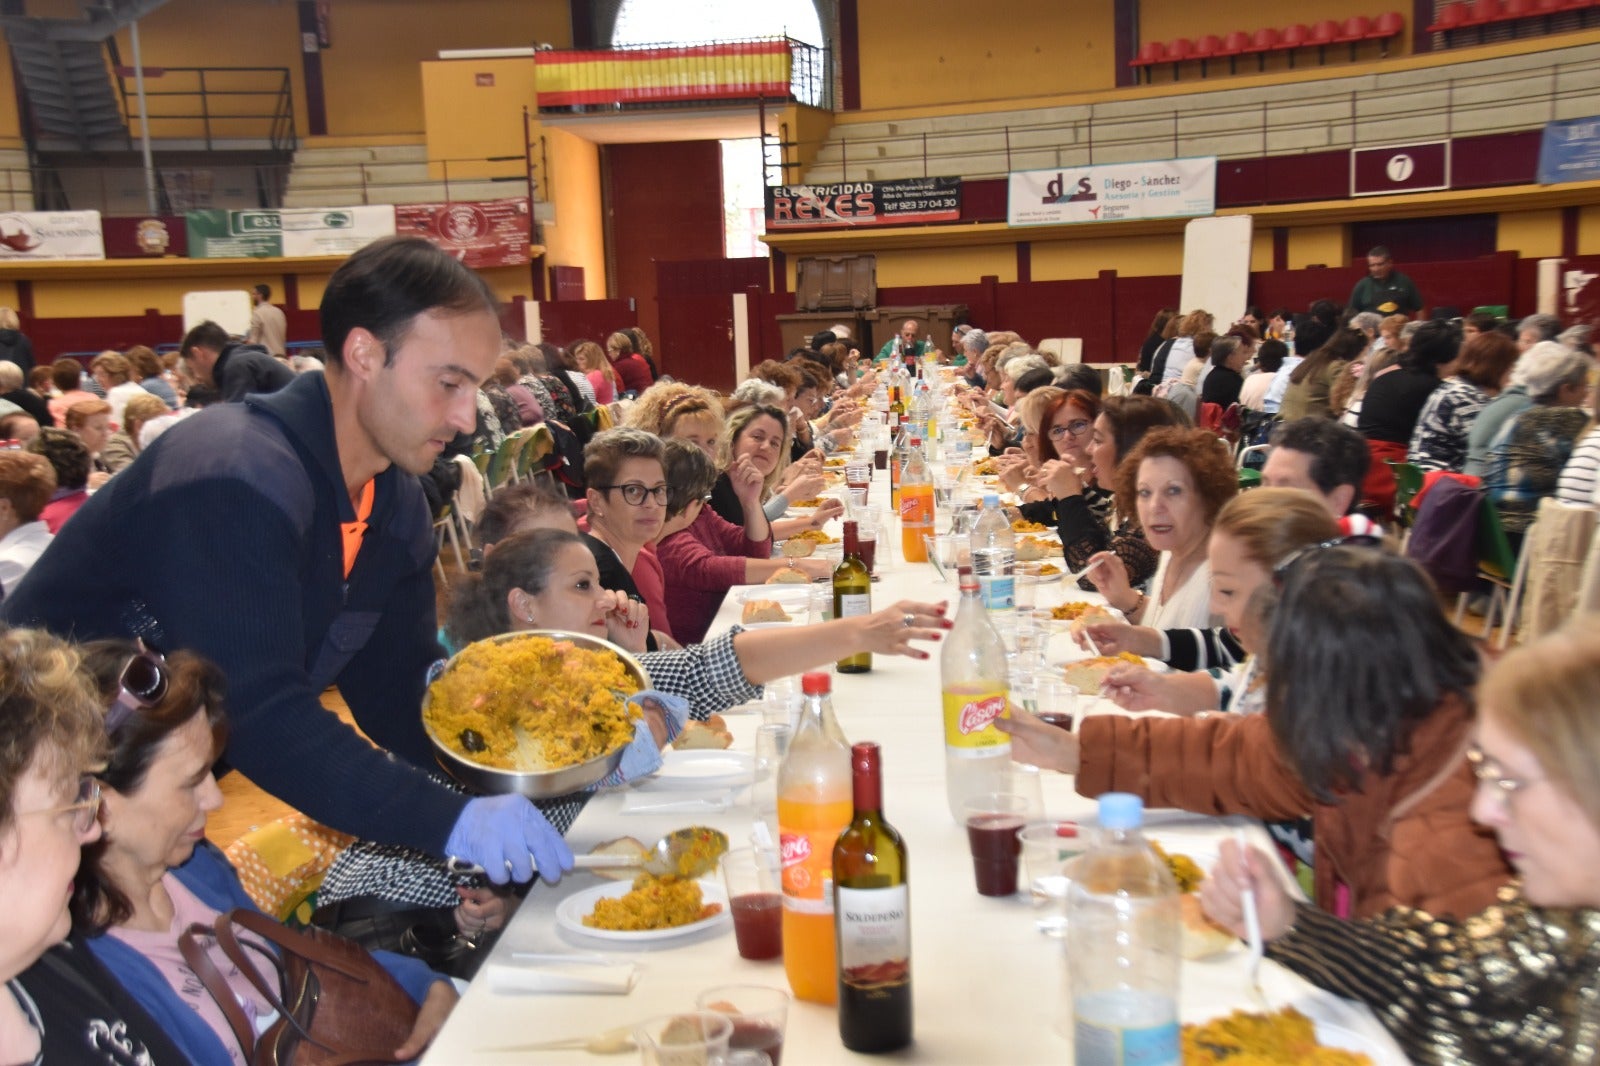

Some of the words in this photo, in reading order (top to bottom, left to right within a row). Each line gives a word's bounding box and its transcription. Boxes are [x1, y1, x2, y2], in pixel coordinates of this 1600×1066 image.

[1394, 158, 1407, 178] 7
[1104, 178, 1132, 192] Diego
[774, 193, 876, 219] REYES
[899, 201, 917, 210] 923
[918, 200, 928, 208] 37
[928, 199, 942, 208] 04
[943, 198, 957, 207] 30
